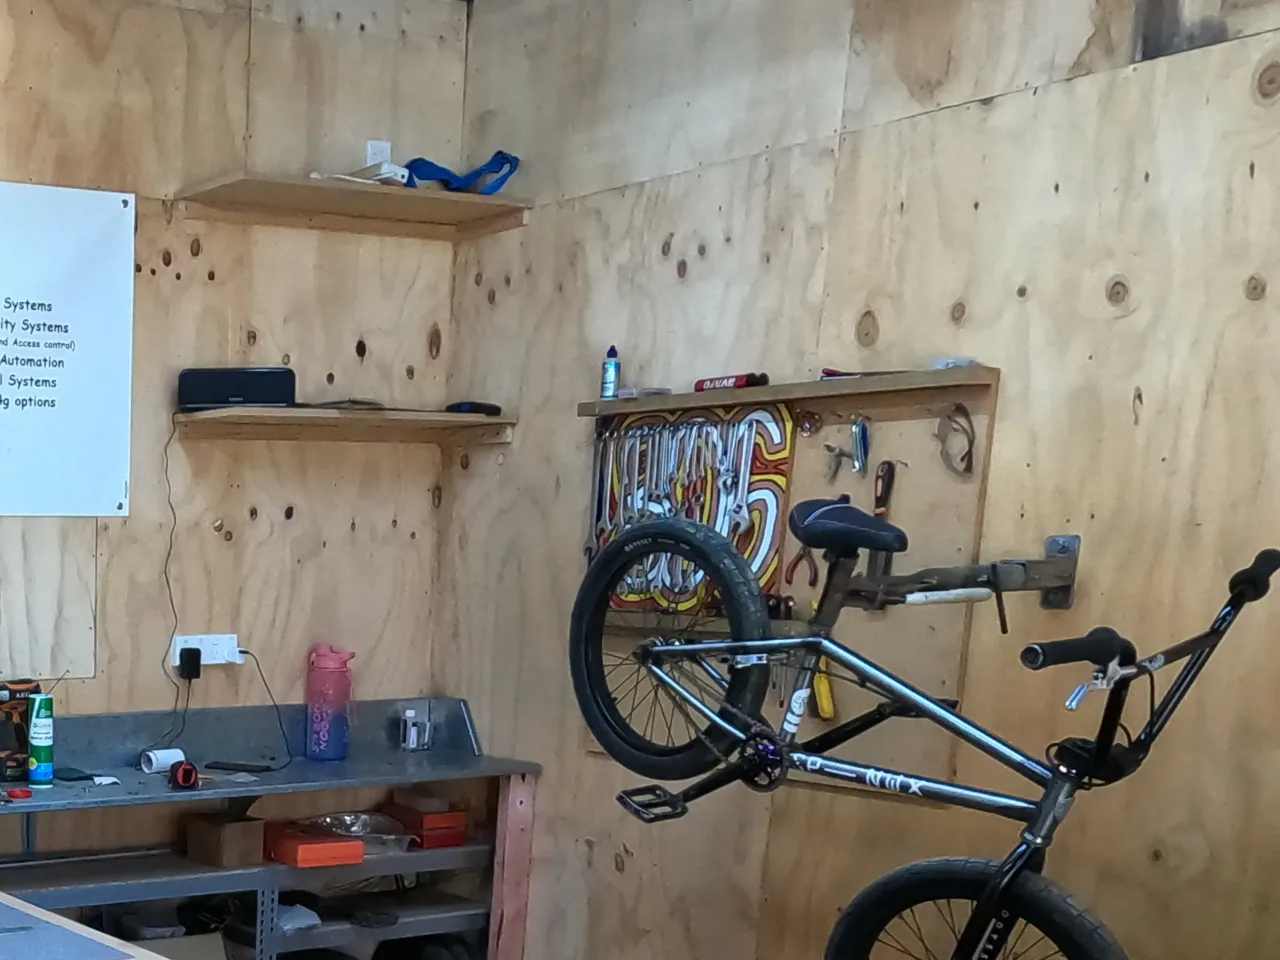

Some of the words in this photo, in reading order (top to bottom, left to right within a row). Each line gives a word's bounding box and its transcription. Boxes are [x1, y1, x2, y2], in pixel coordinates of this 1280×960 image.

[3, 296, 53, 314] Systems
[20, 318, 70, 335] Systems
[12, 337, 40, 348] Access
[43, 340, 76, 352] control)
[0, 353, 65, 369] Automation
[7, 374, 58, 390] Systems
[14, 395, 57, 410] options
